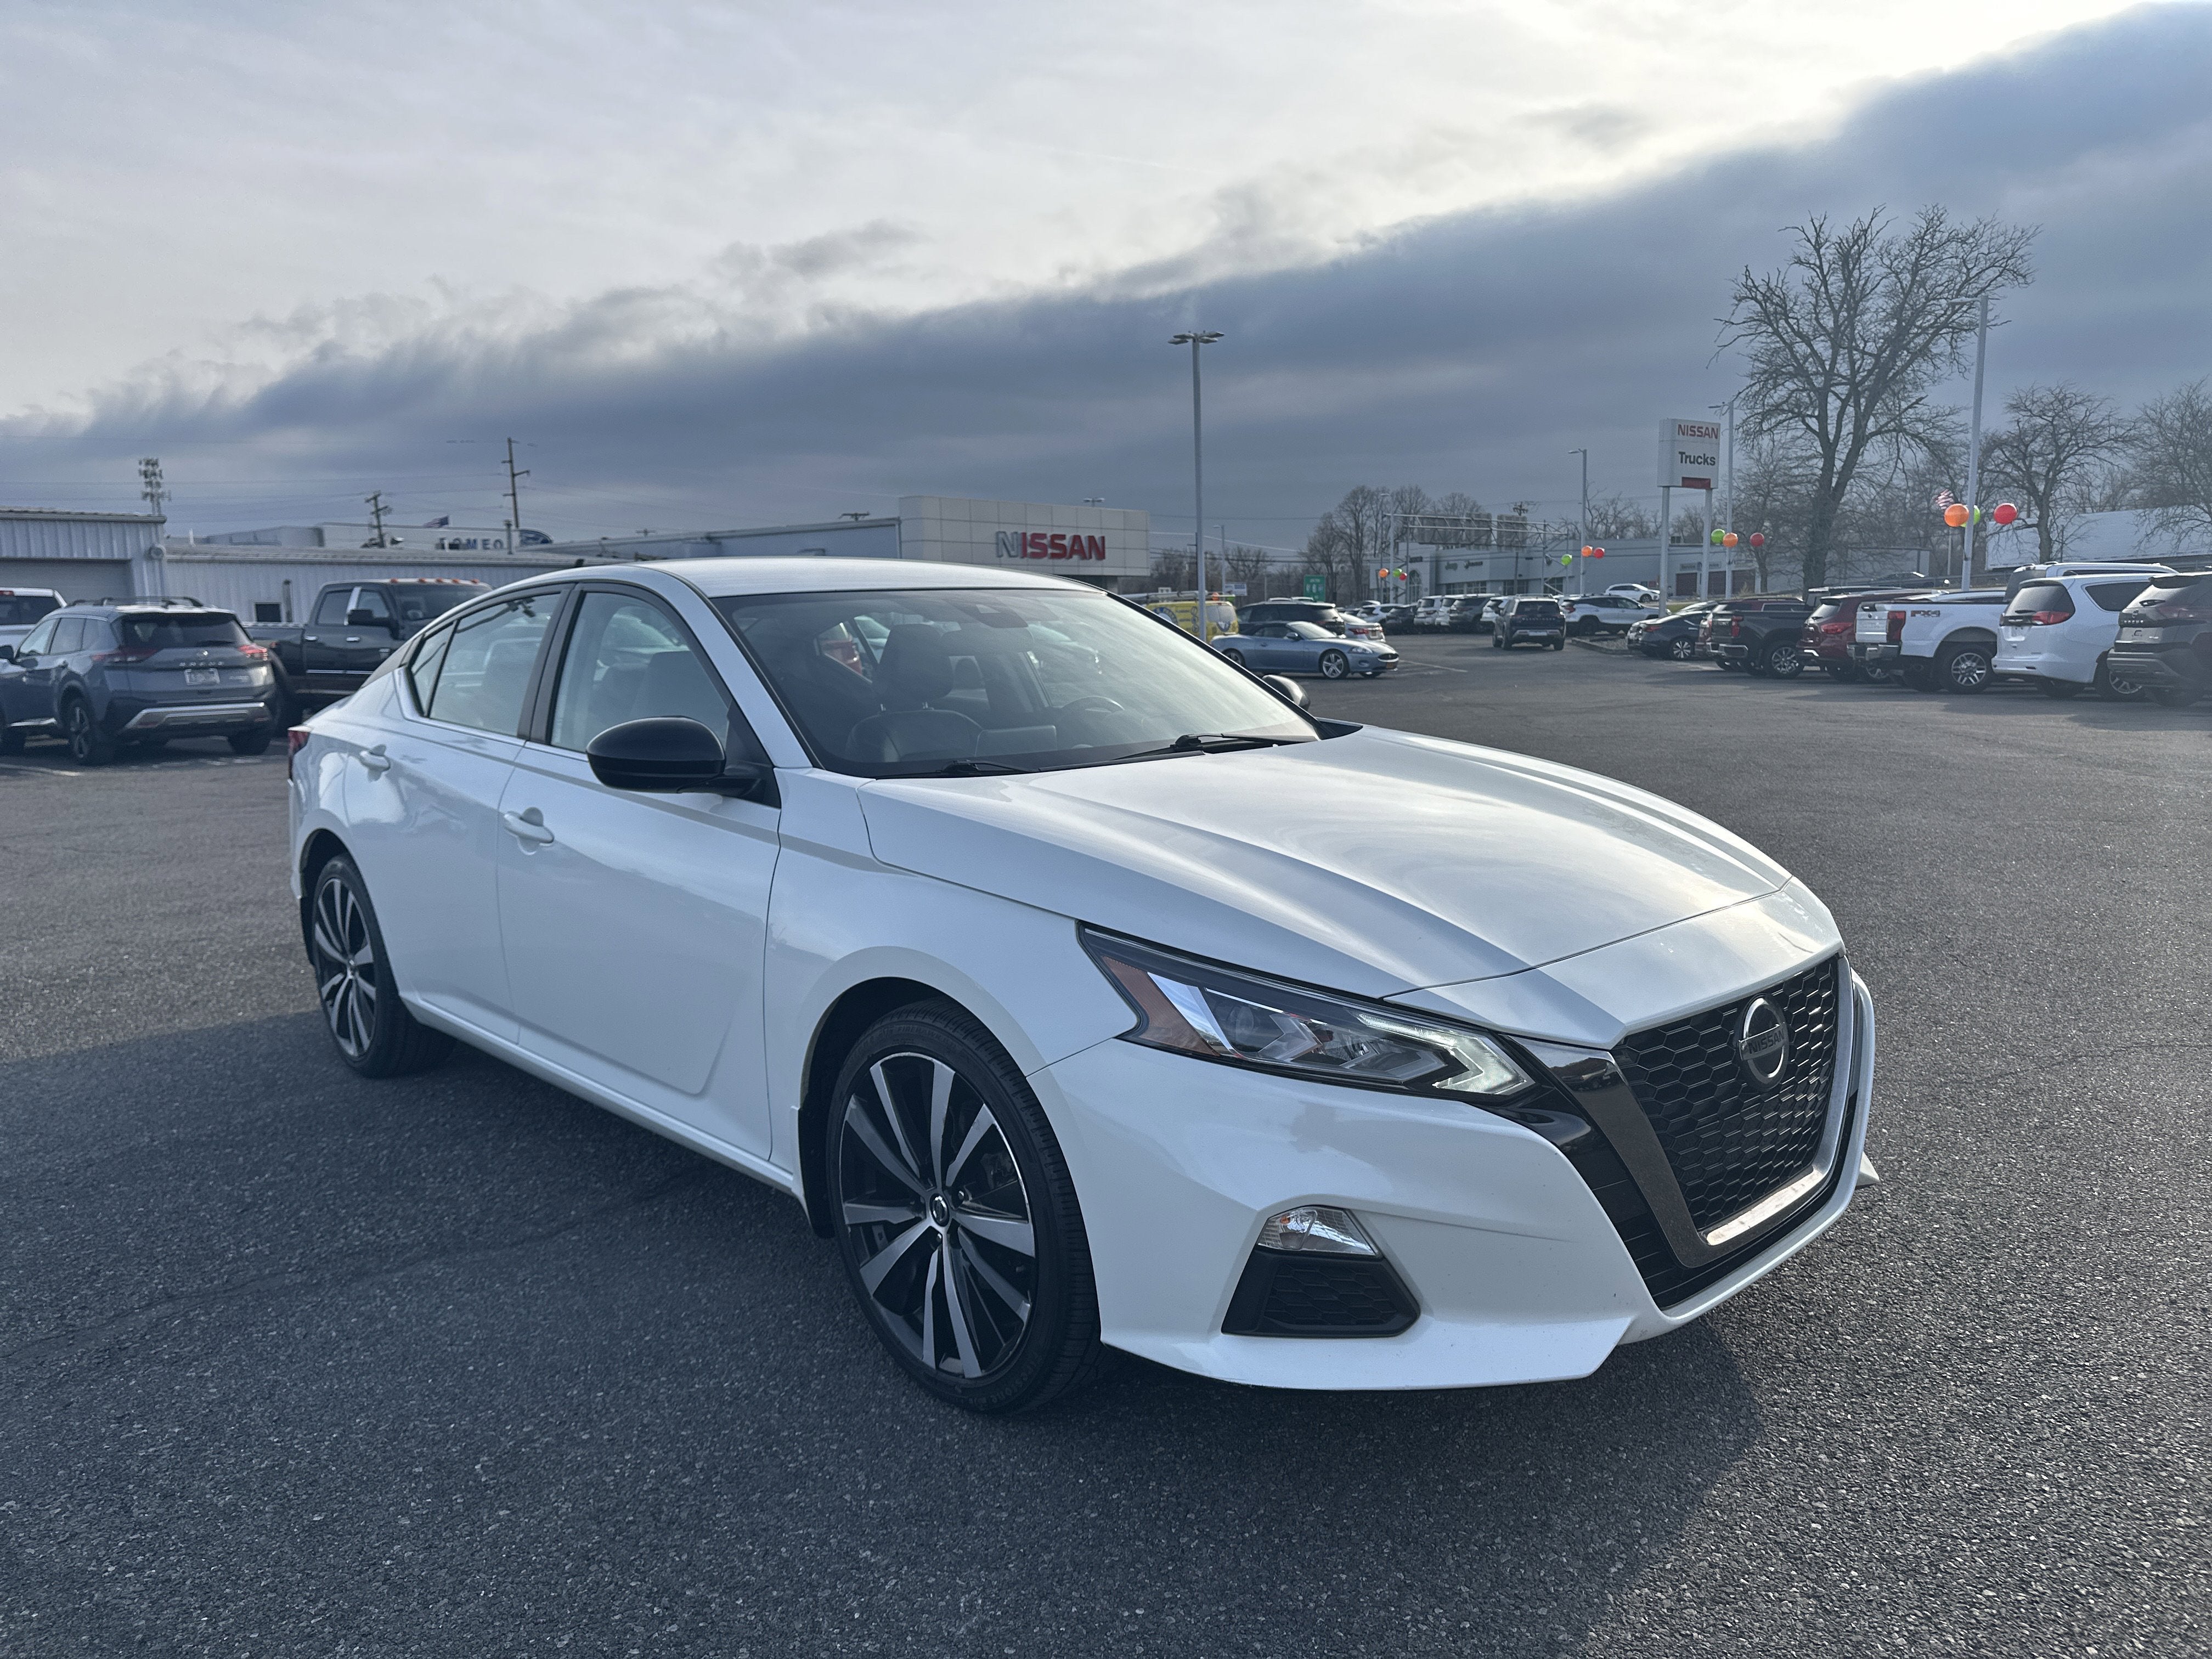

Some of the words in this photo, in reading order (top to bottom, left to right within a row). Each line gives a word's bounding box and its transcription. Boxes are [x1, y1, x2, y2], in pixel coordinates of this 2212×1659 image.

[1678, 424, 1718, 439] NISSAN
[1679, 451, 1716, 466] Trucks
[996, 531, 1105, 560] NISSAN
[1748, 1028, 1784, 1054] NISSAN
